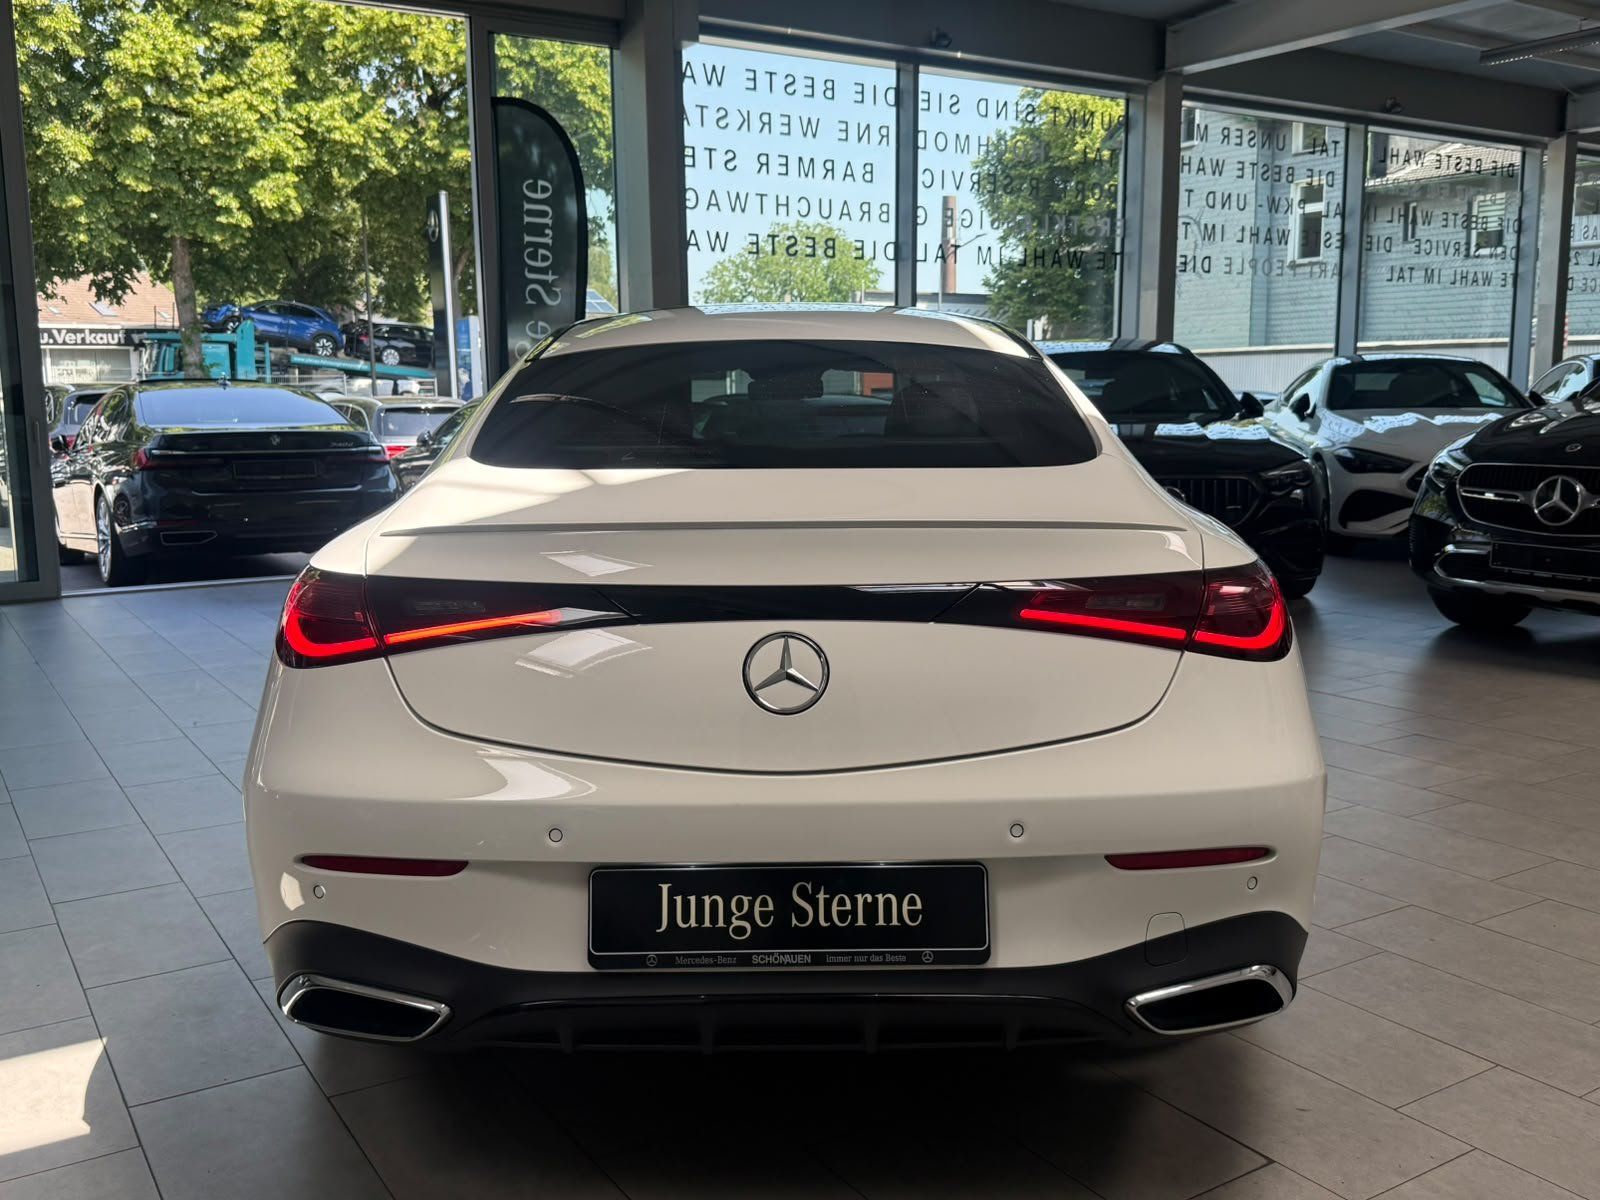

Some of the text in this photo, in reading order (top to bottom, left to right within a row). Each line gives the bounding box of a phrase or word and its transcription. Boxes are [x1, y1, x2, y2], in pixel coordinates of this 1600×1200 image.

[656, 881, 924, 940] Junge Sterne
[675, 952, 907, 965] Mercedes-Benz SCHÖNAUEN Immer nur das Beste
